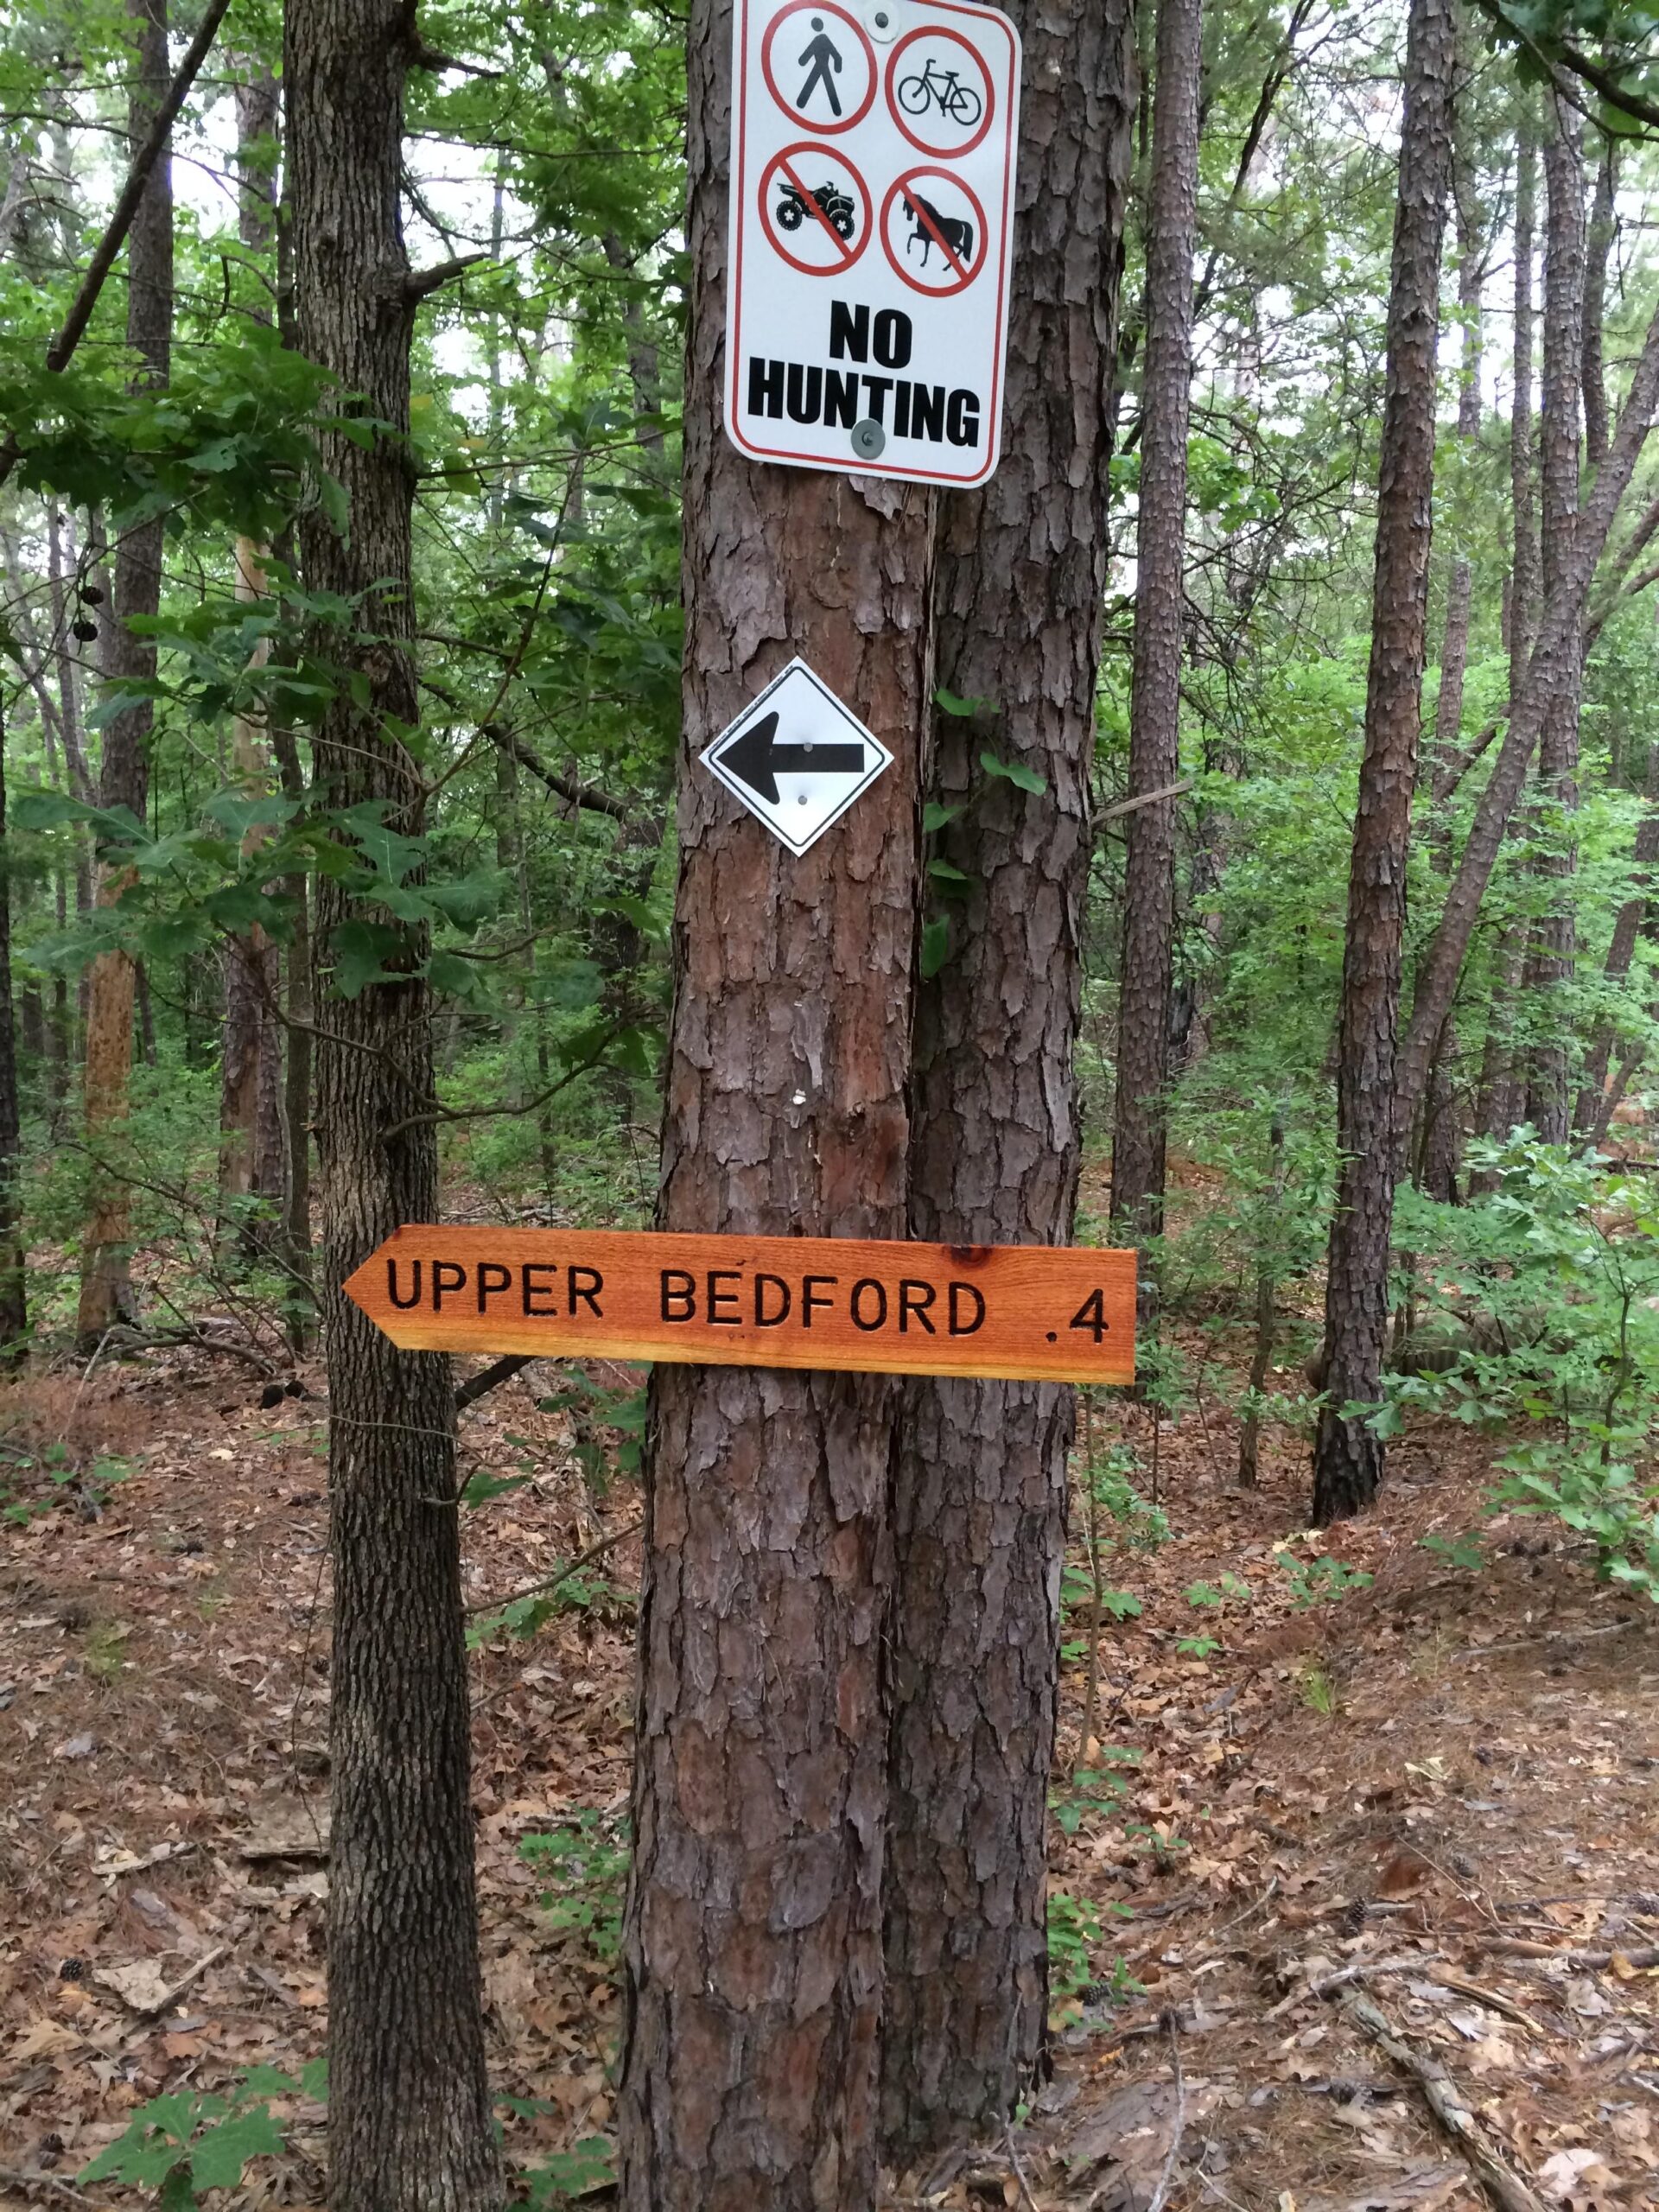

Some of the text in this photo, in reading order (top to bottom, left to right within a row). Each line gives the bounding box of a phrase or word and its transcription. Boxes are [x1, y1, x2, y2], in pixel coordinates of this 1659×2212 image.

[830, 300, 912, 369] NO
[748, 357, 980, 447] HUNTING
[387, 1258, 1109, 1343] UPPER BEDFORD .4
